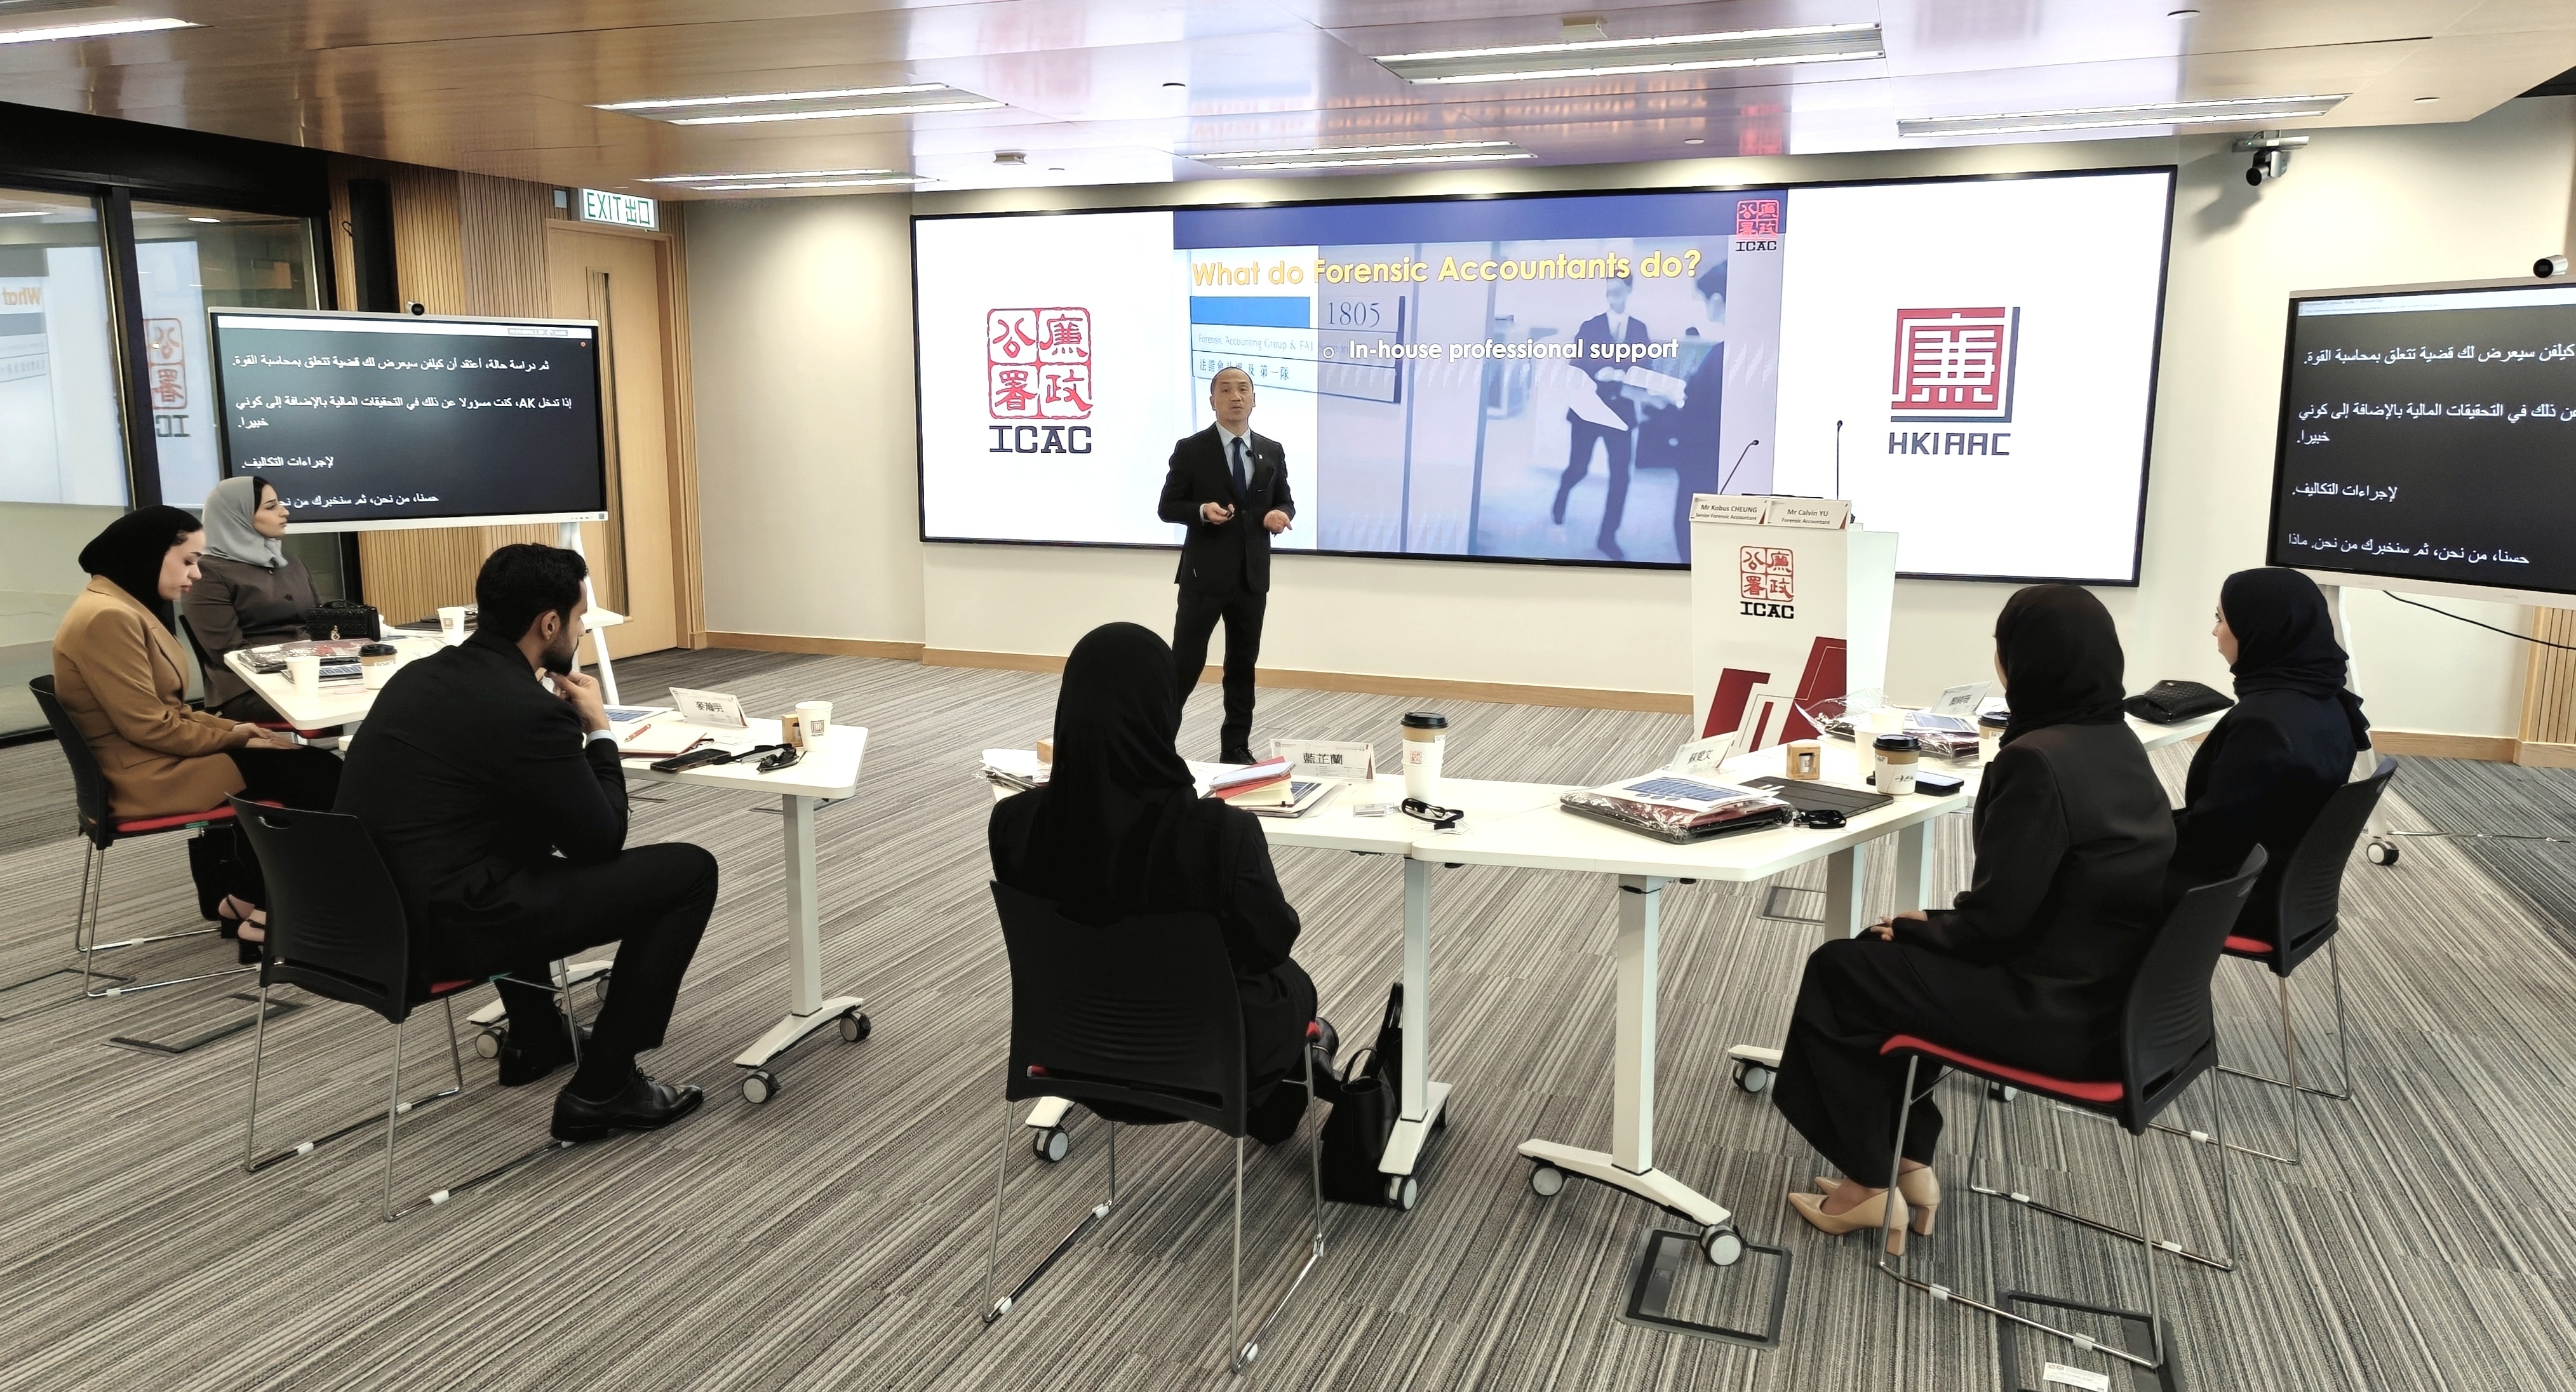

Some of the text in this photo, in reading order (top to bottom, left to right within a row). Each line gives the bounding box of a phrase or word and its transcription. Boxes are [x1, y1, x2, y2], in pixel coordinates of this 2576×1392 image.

[587, 192, 650, 225] EXIT 出口
[1735, 241, 1777, 251] ICAC
[1191, 249, 1701, 286] What do Forensic Accountants do?
[1327, 302, 1380, 328] 1805
[1349, 338, 1442, 359] In-house
[1449, 337, 1583, 363] professional
[1589, 337, 1679, 363] support
[2304, 344, 2575, 365] كيلفن سيعرض لك قضية تتعلق بمحاسبة القوة.
[232, 354, 257, 367] القوة.
[261, 355, 301, 367] بمحاسبة
[304, 356, 330, 368] تتعلق
[333, 356, 359, 368] قضية
[362, 357, 375, 366] لك
[378, 359, 418, 370] سيعرض
[420, 358, 444, 370] كيلفن
[447, 358, 457, 370] أن
[510, 360, 535, 372] دراسة
[539, 361, 549, 370] ثم
[236, 396, 262, 410] كوني
[266, 396, 281, 408] إلى
[285, 396, 327, 408] بالإضافة
[330, 396, 358, 408] المالية
[361, 397, 403, 408] التحقيقات
[406, 398, 419, 410] في
[422, 397, 439, 406] ذلك
[441, 399, 455, 408] عن
[459, 398, 491, 409] مسؤولا
[539, 398, 560, 408] تدخل
[562, 398, 571, 408] إذا
[2299, 403, 2327, 420] كوني
[2331, 403, 2349, 419] إلى
[2353, 403, 2402, 420] بالإضافة
[2406, 403, 2441, 418] المالية
[2446, 403, 2503, 419] التحقيقات
[2508, 405, 2526, 423] في
[2531, 404, 2556, 417] ذلك
[238, 417, 269, 429] خبيرا.
[989, 425, 1092, 454] ICAC
[1888, 432, 2011, 455] HKIAAC
[2297, 430, 2330, 445] خبيرا.
[242, 457, 333, 469] لإجراءات التكاليف.
[2292, 483, 2398, 502] لإجراءات التكاليف.
[294, 499, 309, 508] من
[312, 495, 351, 507] سنخبرك
[355, 494, 366, 505] ثم
[396, 496, 410, 505] من
[2289, 533, 2529, 563] حسنا، من نحن، ثم سنخبرك من نحن. ماذا
[1740, 601, 1794, 619] ICAC
